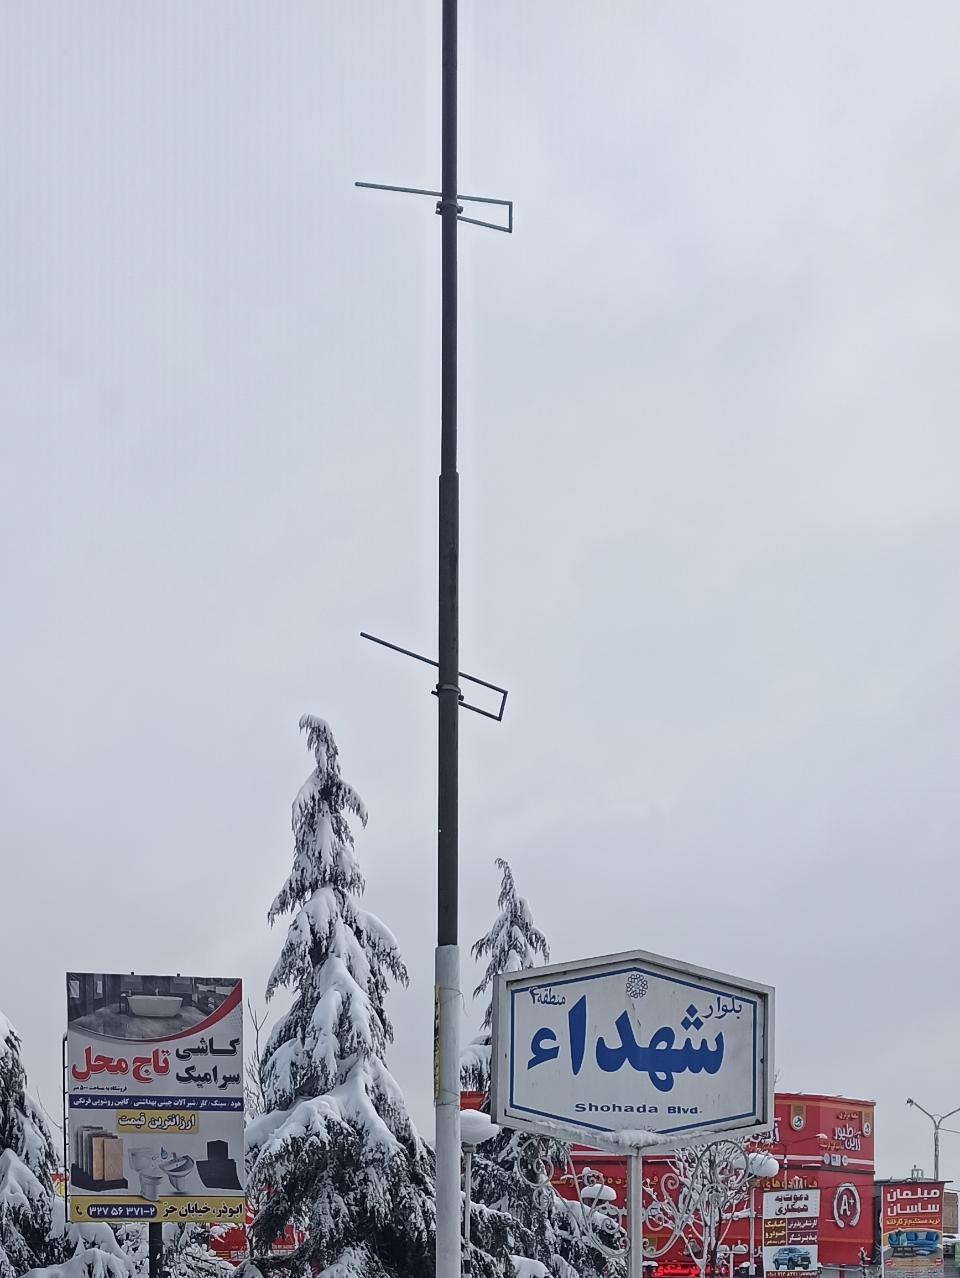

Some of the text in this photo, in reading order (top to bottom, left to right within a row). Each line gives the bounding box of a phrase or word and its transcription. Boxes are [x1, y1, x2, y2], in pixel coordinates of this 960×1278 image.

[702, 996, 743, 1020] بلوار
[176, 1037, 240, 1061] کاشی
[527, 994, 726, 1093] شهداء
[71, 1046, 171, 1084] تاج محل
[176, 1065, 241, 1090] سرامیک
[575, 1102, 703, 1115] Shohada Blvd.
[118, 1111, 196, 1131] ارزانترین قیمت
[774, 1194, 809, 1204] دعوت به
[886, 1187, 940, 1202] مبلمان
[89, 1205, 108, 1216] ۳۲۷
[111, 1205, 124, 1216] ۵۶
[179, 1202, 211, 1217] خیابان
[775, 1204, 809, 1216] همکاری
[887, 1202, 940, 1217] ساسان
